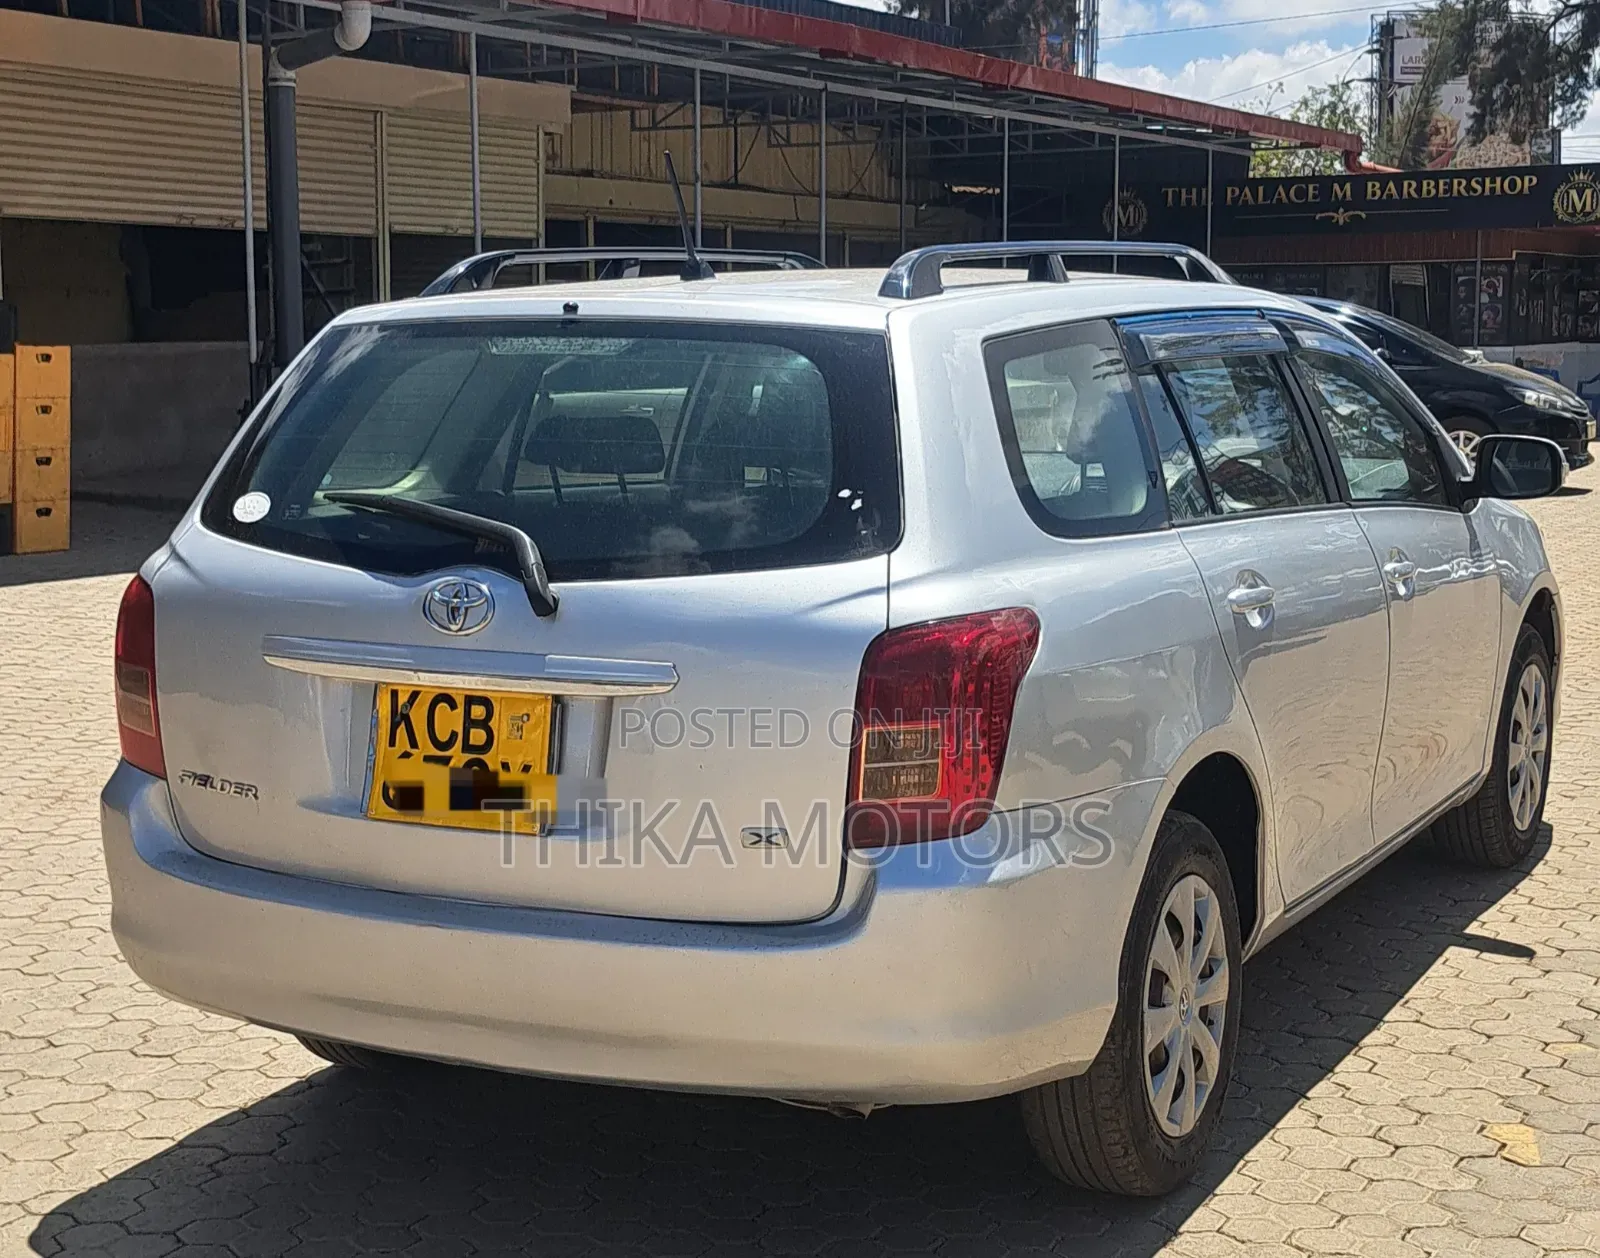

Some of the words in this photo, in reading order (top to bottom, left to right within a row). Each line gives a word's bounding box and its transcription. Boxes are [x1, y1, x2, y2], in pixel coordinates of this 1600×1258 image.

[1225, 183, 1320, 206] PALACE
[1331, 182, 1352, 201] M
[1366, 175, 1538, 200] BARBERSHOP
[388, 689, 495, 755] KCB
[178, 769, 259, 800] FIELDER
